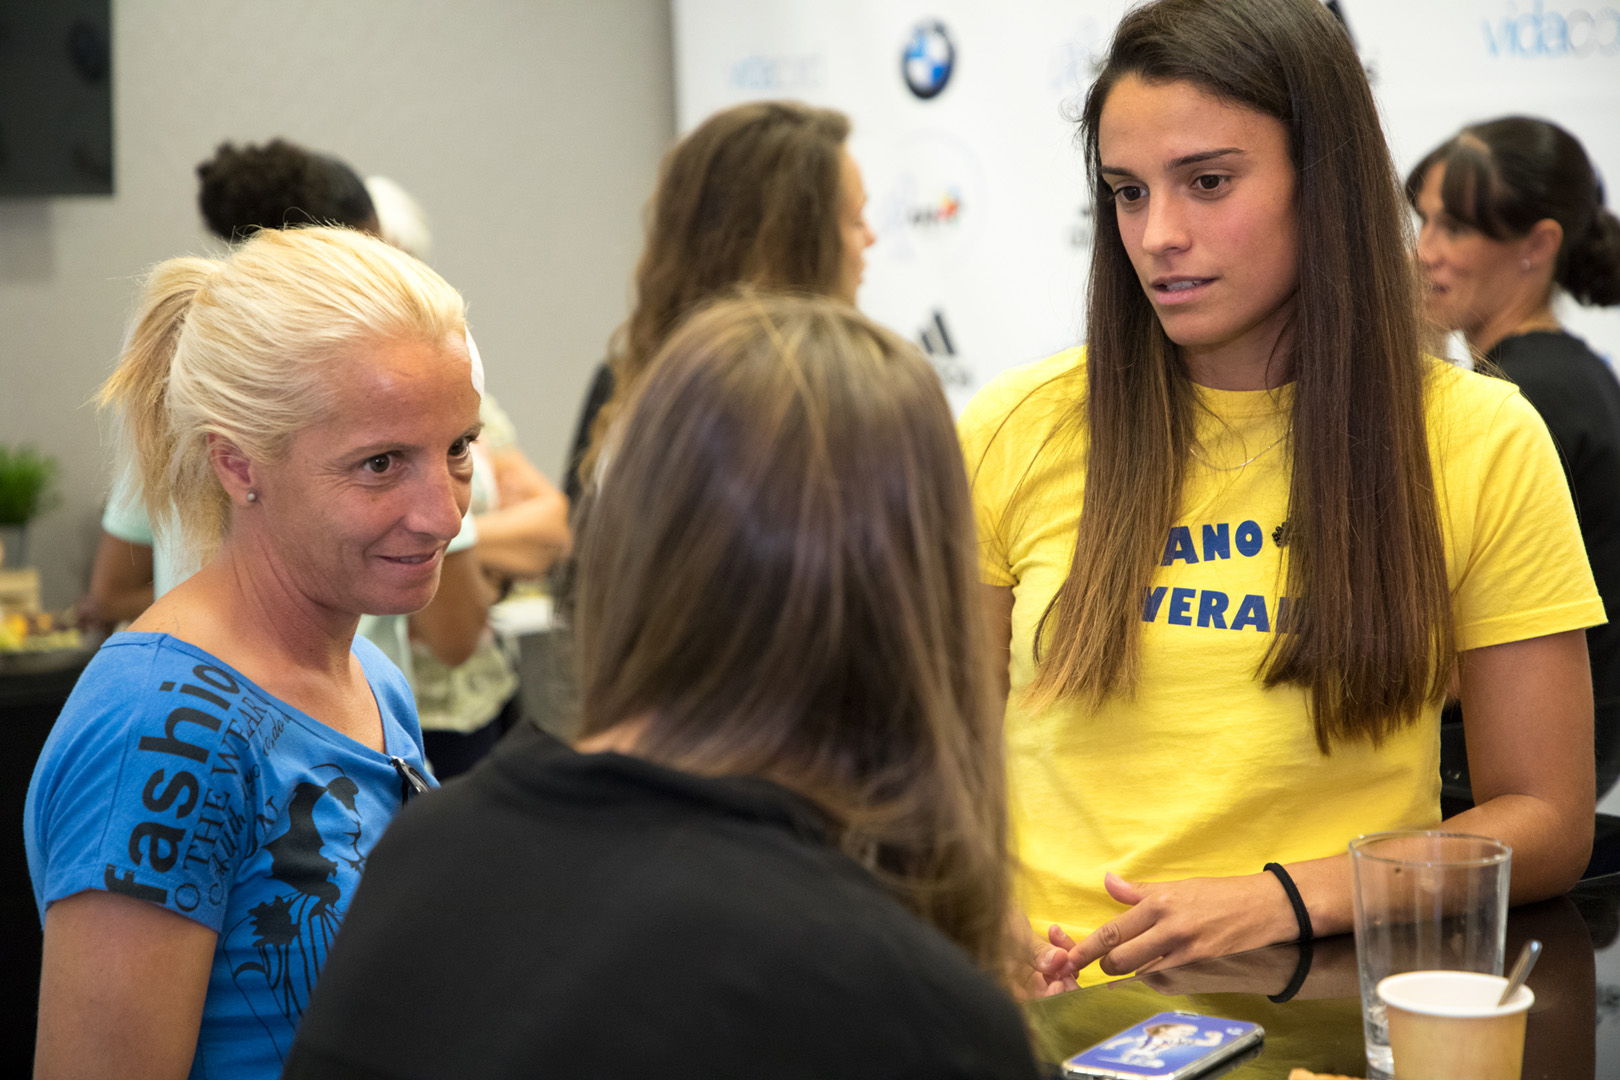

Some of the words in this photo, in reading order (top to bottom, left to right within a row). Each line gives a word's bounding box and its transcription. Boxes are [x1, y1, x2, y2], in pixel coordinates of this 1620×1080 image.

[1156, 520, 1263, 567] ANO
[183, 788, 230, 870] THE
[210, 690, 270, 775] WEAR
